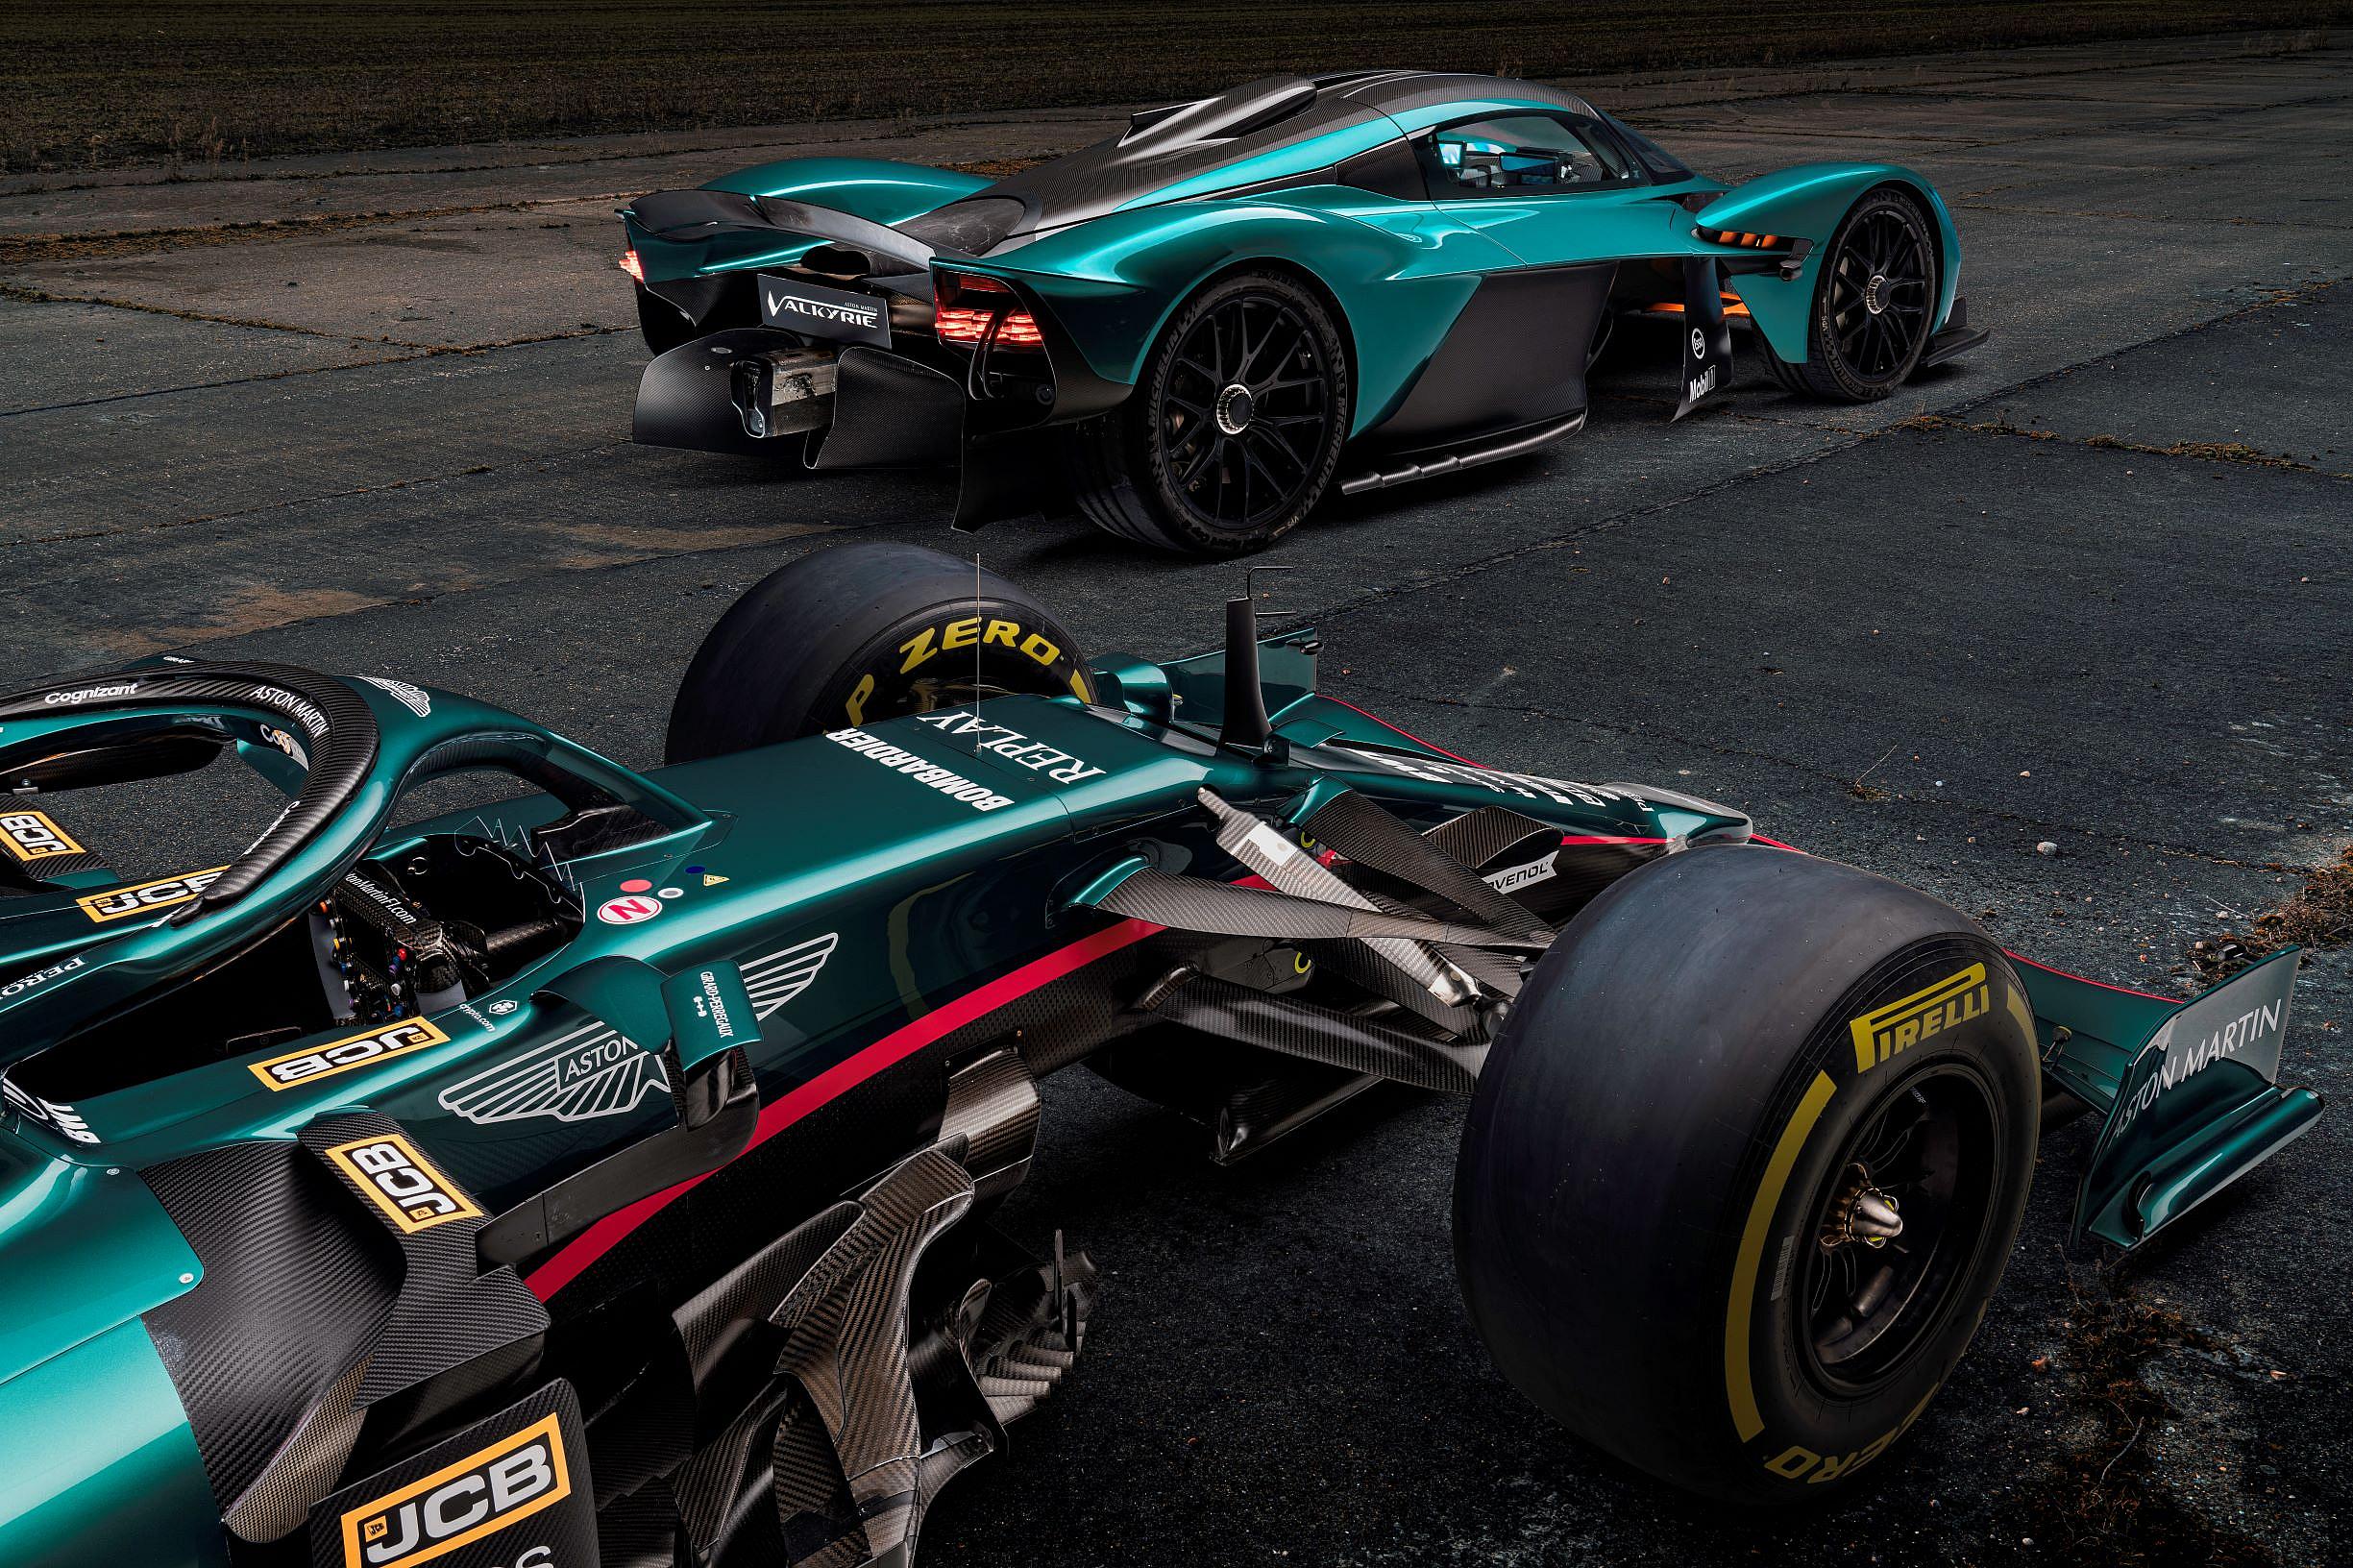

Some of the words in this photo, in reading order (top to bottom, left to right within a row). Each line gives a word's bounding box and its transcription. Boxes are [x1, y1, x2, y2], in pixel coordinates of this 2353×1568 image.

[768, 290, 877, 329] VALKYRIE
[1689, 370, 1708, 403] Mobil
[1317, 397, 1345, 488] MICHELIN
[899, 616, 1060, 674] ZERO
[45, 682, 137, 704] Cognizant
[250, 685, 296, 710] ASTON
[292, 698, 330, 738] MARTIN
[825, 727, 1015, 811] BOMBARDIER
[916, 711, 1107, 784] REPLAY
[1, 815, 67, 851] JCB
[345, 871, 417, 924] tonMartinF1.com
[0, 957, 87, 1000] PERO
[700, 971, 733, 1038] GIRARD-PERREGAUX
[459, 1003, 496, 1032] crypto.com
[1850, 962, 1990, 1074] PIRELLI
[272, 1026, 422, 1082] JCB
[2114, 1057, 2176, 1138] ASTON
[2181, 999, 2281, 1082] MARTIN
[352, 1143, 456, 1213] JCB
[366, 1444, 551, 1563] JCB
